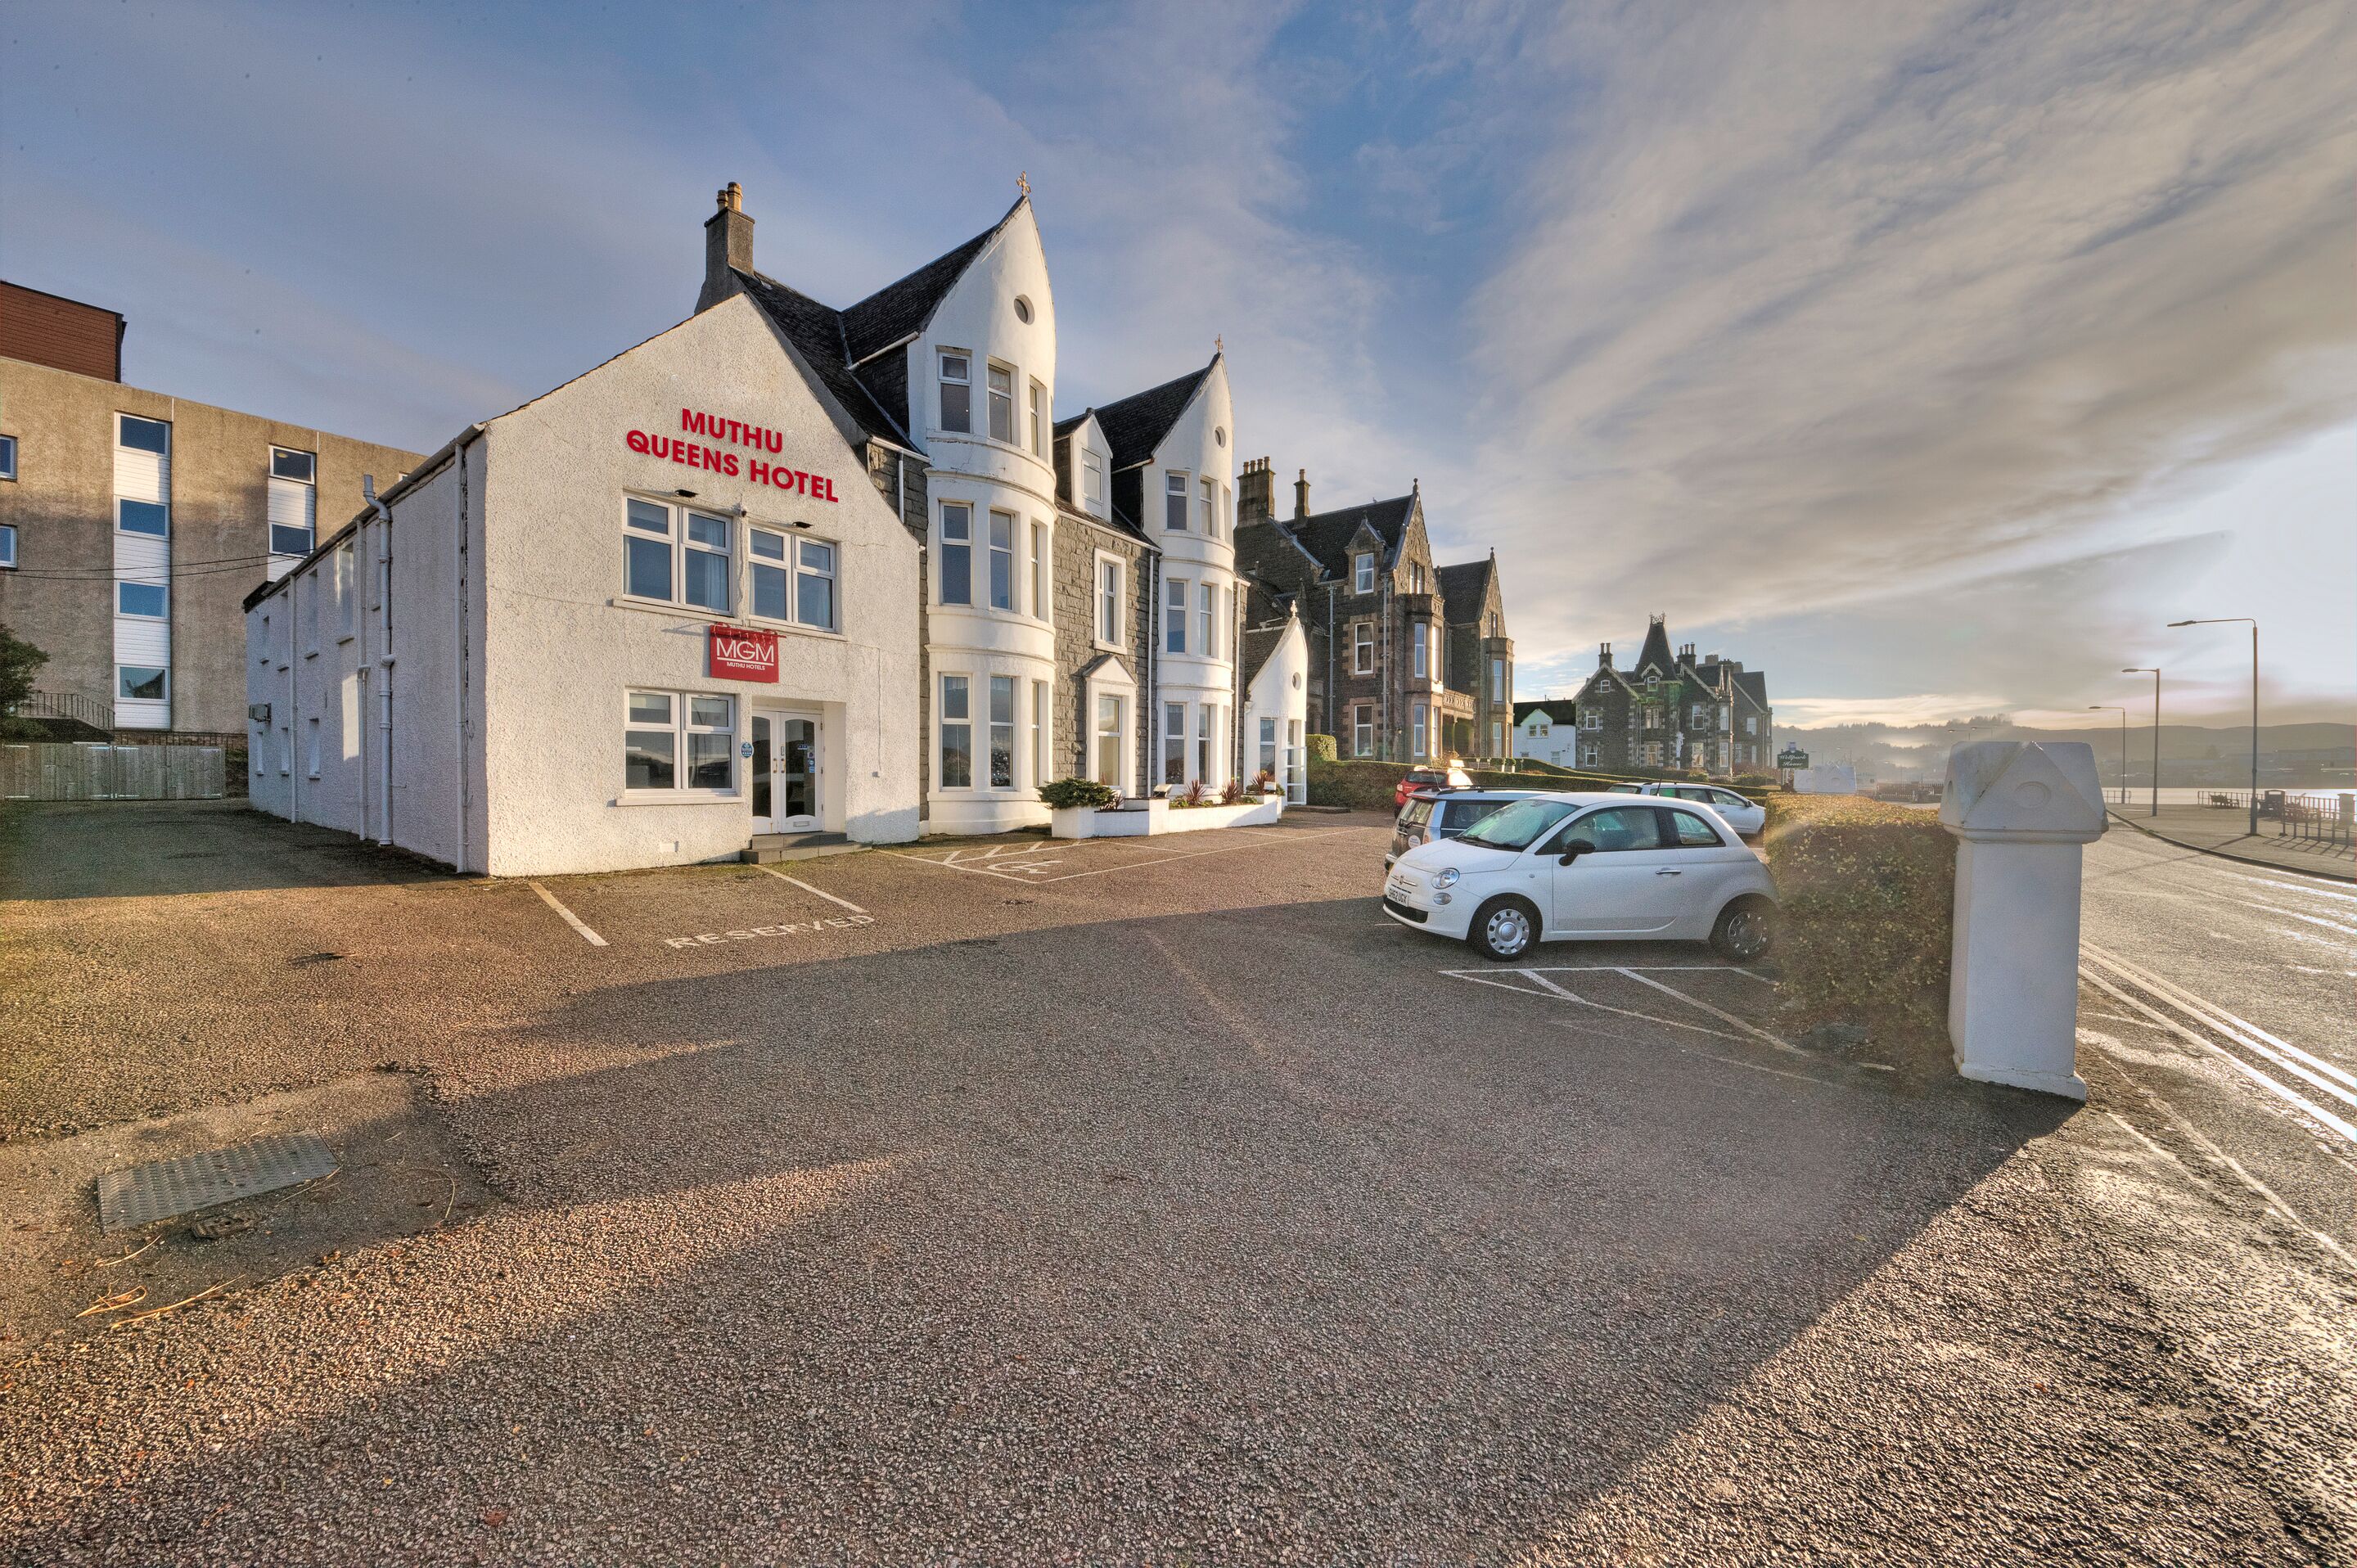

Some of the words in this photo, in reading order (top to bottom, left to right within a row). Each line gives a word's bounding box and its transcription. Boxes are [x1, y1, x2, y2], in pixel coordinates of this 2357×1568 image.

[682, 408, 782, 454] MUTHU
[626, 430, 740, 477] QUEENS
[750, 459, 839, 503] HOTEL
[716, 638, 774, 663] MGM
[665, 915, 875, 949] RESERVED
